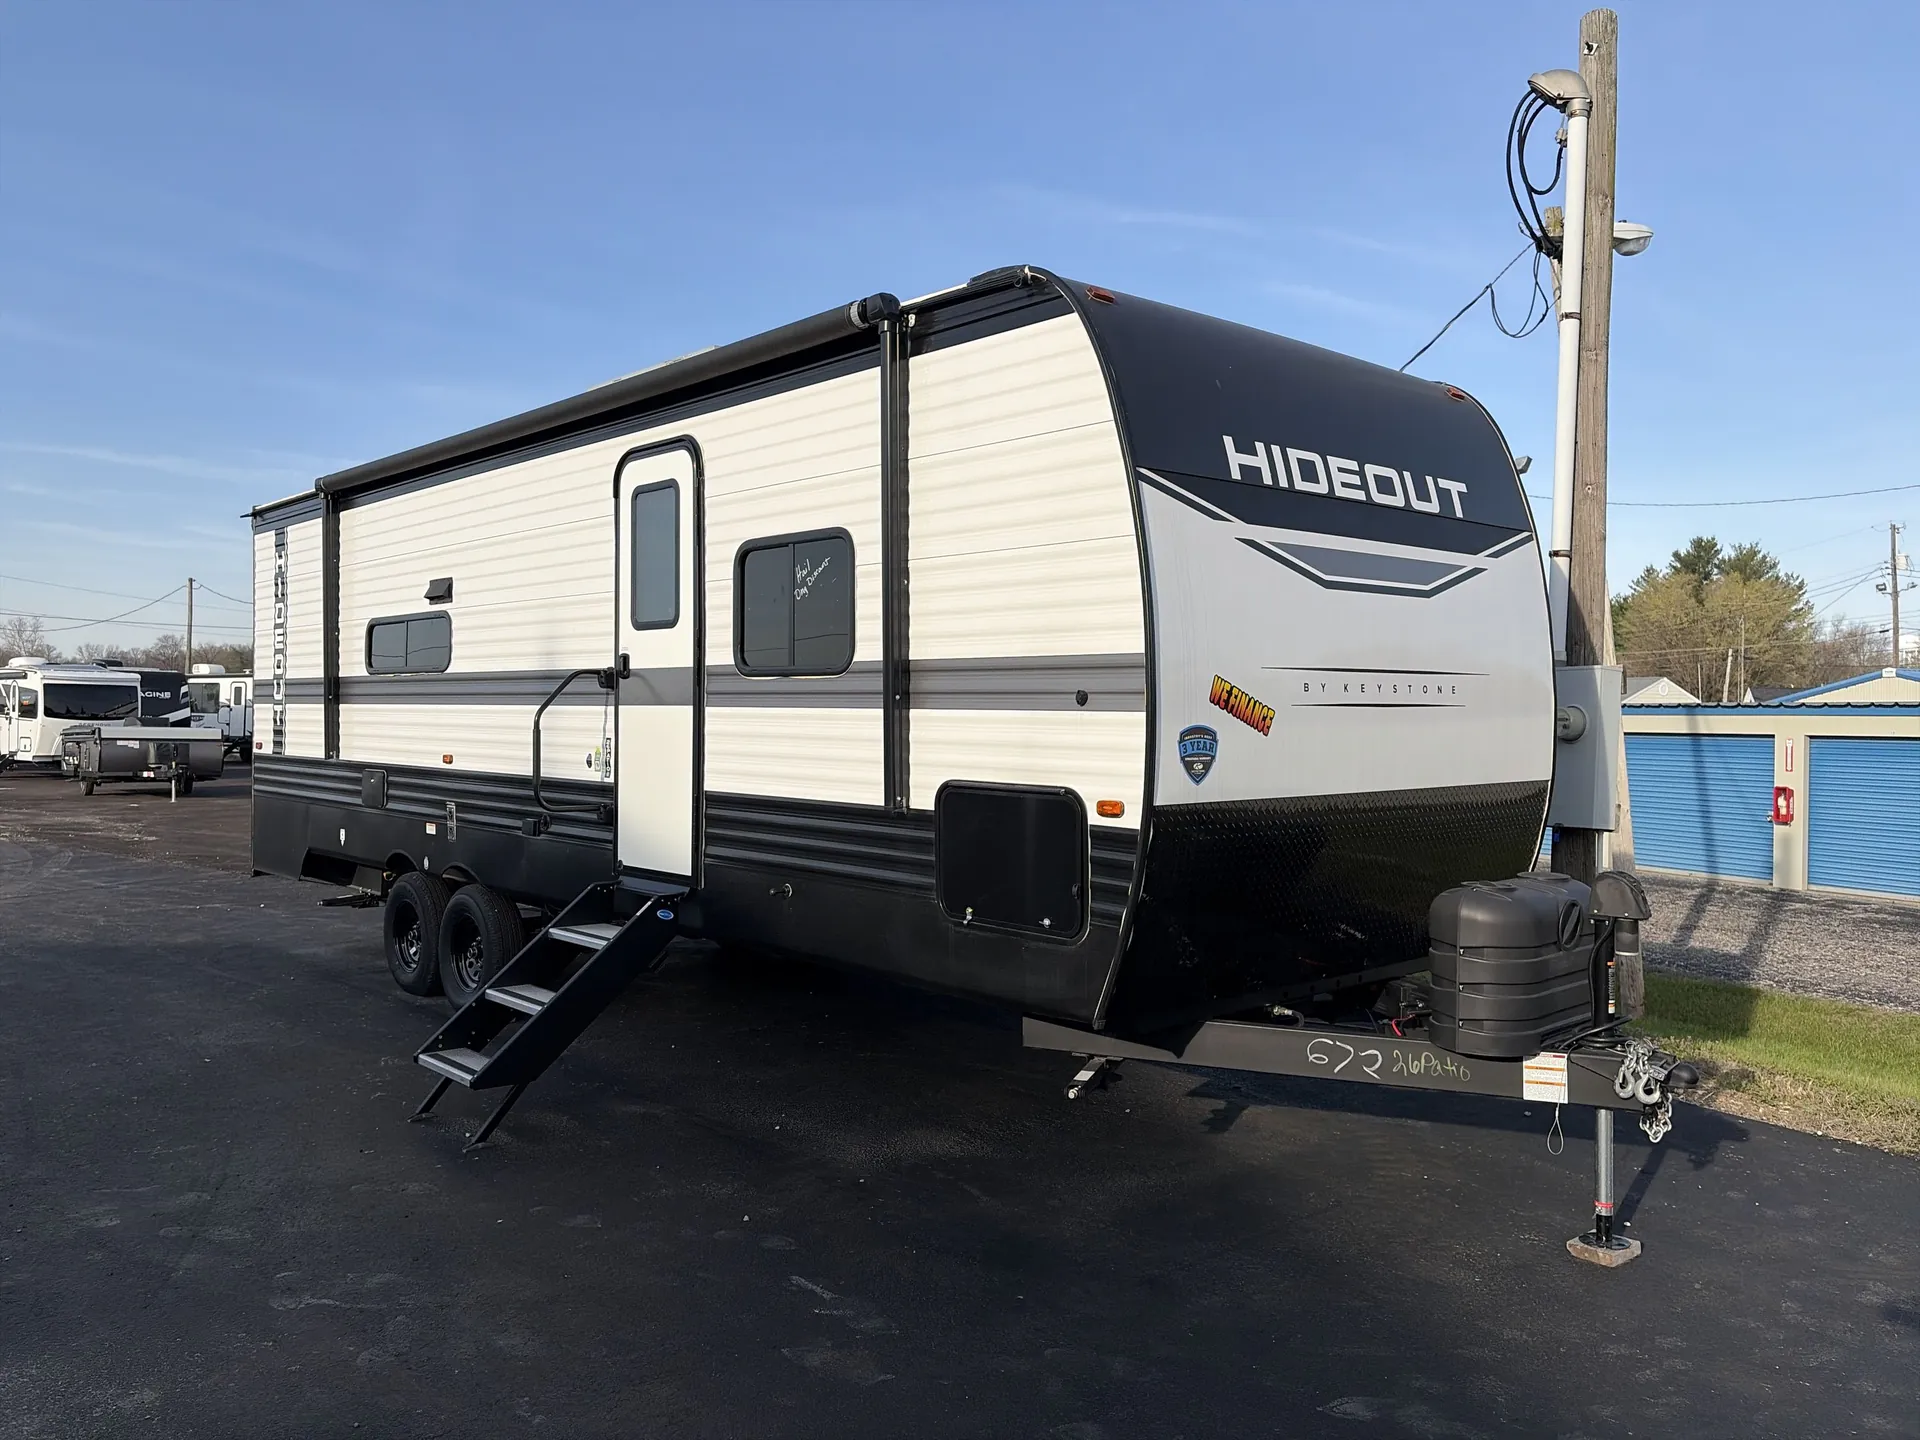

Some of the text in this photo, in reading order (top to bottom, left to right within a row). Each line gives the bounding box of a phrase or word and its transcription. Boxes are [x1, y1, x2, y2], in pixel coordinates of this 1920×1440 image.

[1222, 434, 1468, 518] HIDEOUT
[795, 558, 811, 584] Hail
[273, 550, 285, 726] HIDEOUT
[1209, 674, 1275, 737] WE FINANCE
[1303, 682, 1456, 695] BY KEYSTONE
[1181, 740, 1215, 754] 3 YEAR
[1306, 1038, 1383, 1080] 672
